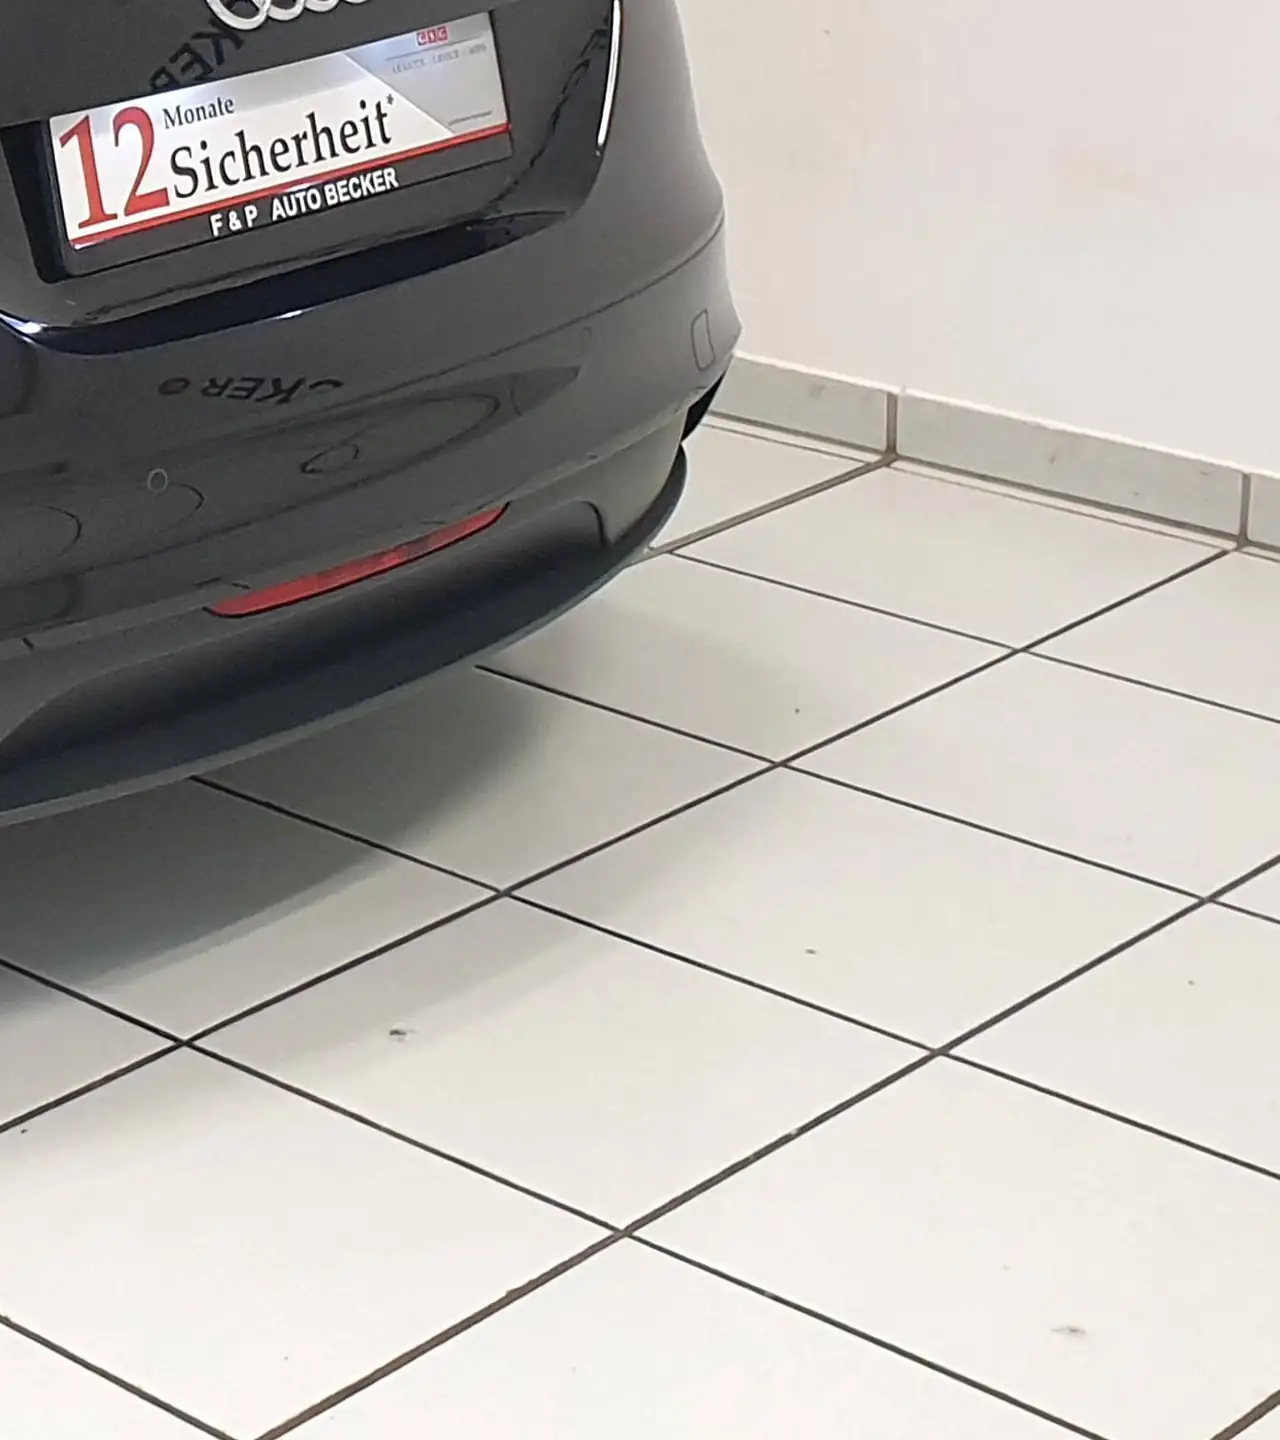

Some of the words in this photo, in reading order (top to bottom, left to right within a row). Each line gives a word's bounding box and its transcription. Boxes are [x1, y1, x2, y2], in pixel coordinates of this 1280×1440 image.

[59, 106, 170, 229] 12
[163, 96, 236, 130] Monate
[210, 212, 223, 237] F
[228, 211, 242, 232] &
[244, 204, 258, 228] P
[272, 189, 322, 222] AUTO
[323, 166, 399, 207] BECKER
